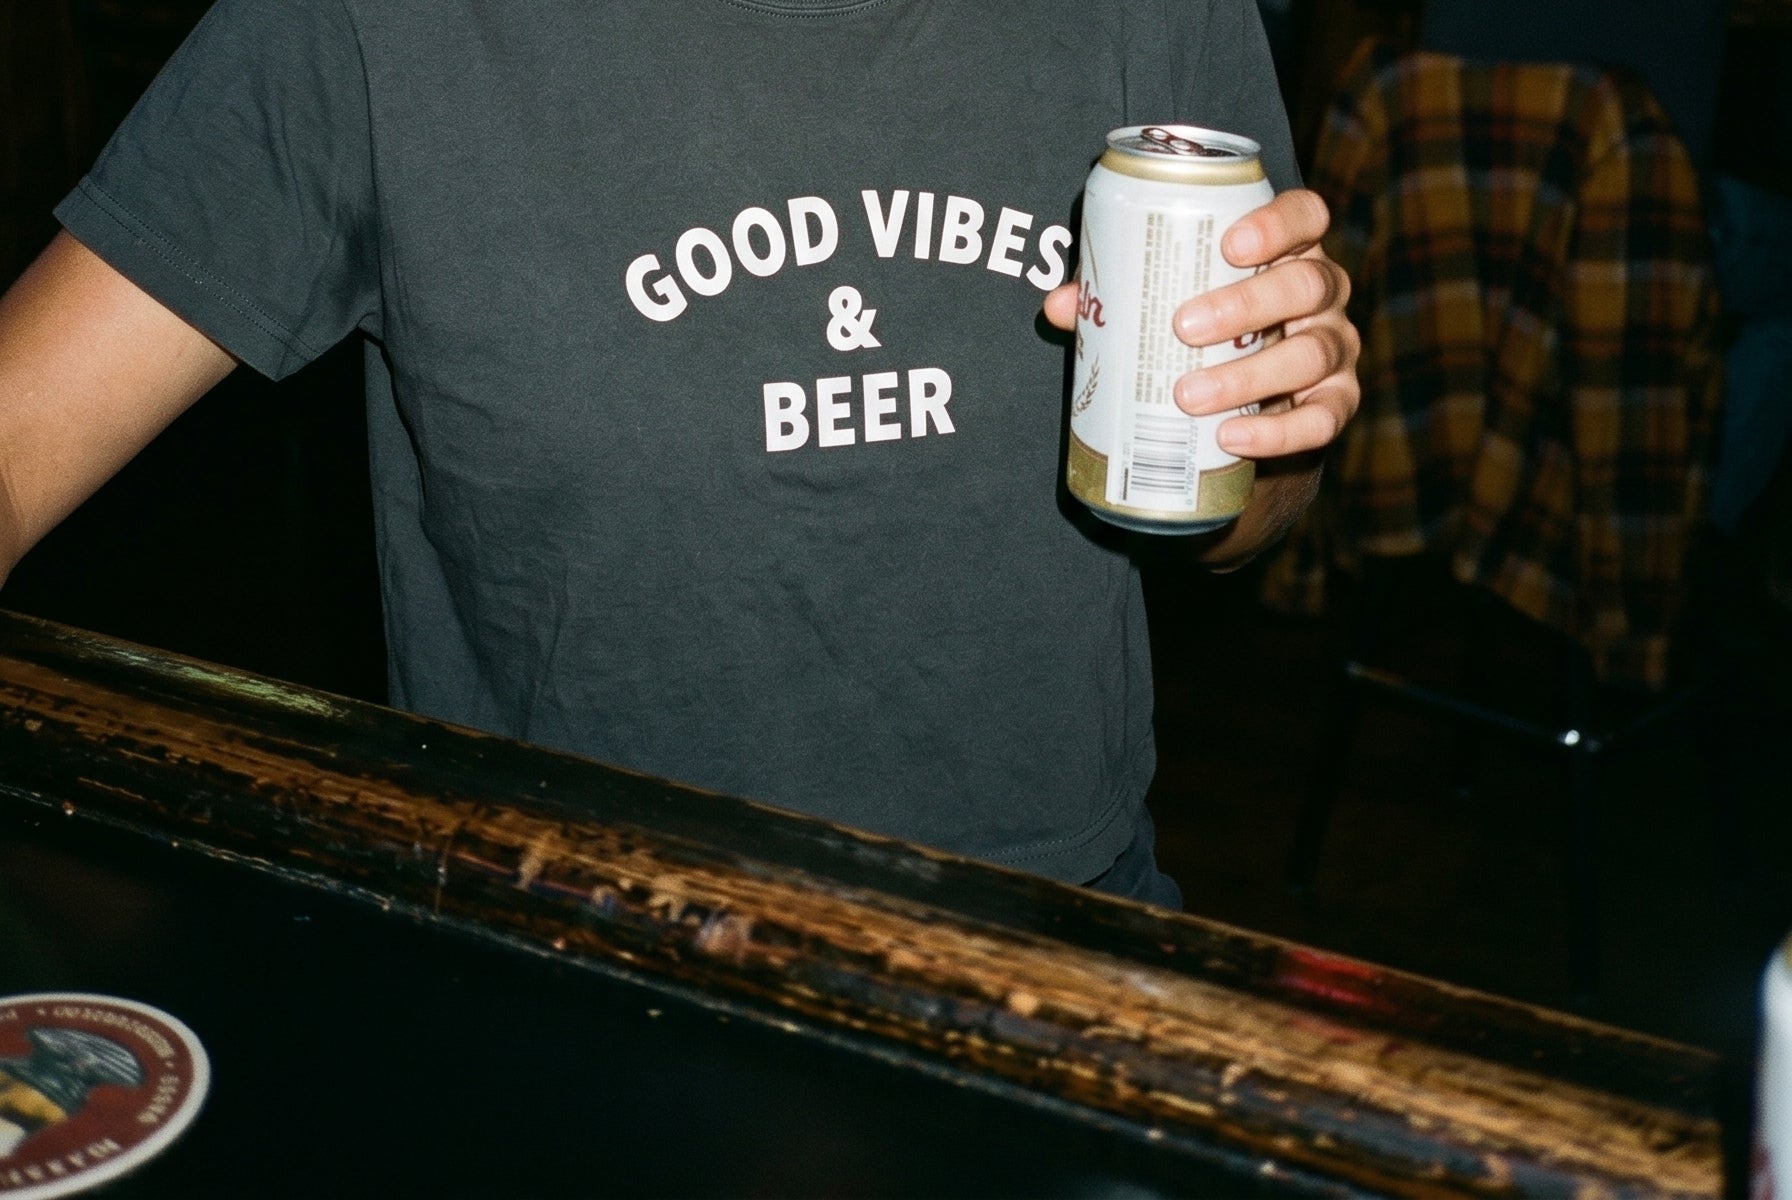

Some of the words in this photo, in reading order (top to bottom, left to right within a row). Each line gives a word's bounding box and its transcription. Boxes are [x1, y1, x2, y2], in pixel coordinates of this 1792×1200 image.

[625, 196, 839, 321] GOOD
[862, 190, 1073, 291] VIBES
[827, 286, 882, 351] &
[763, 367, 955, 452] BEER
